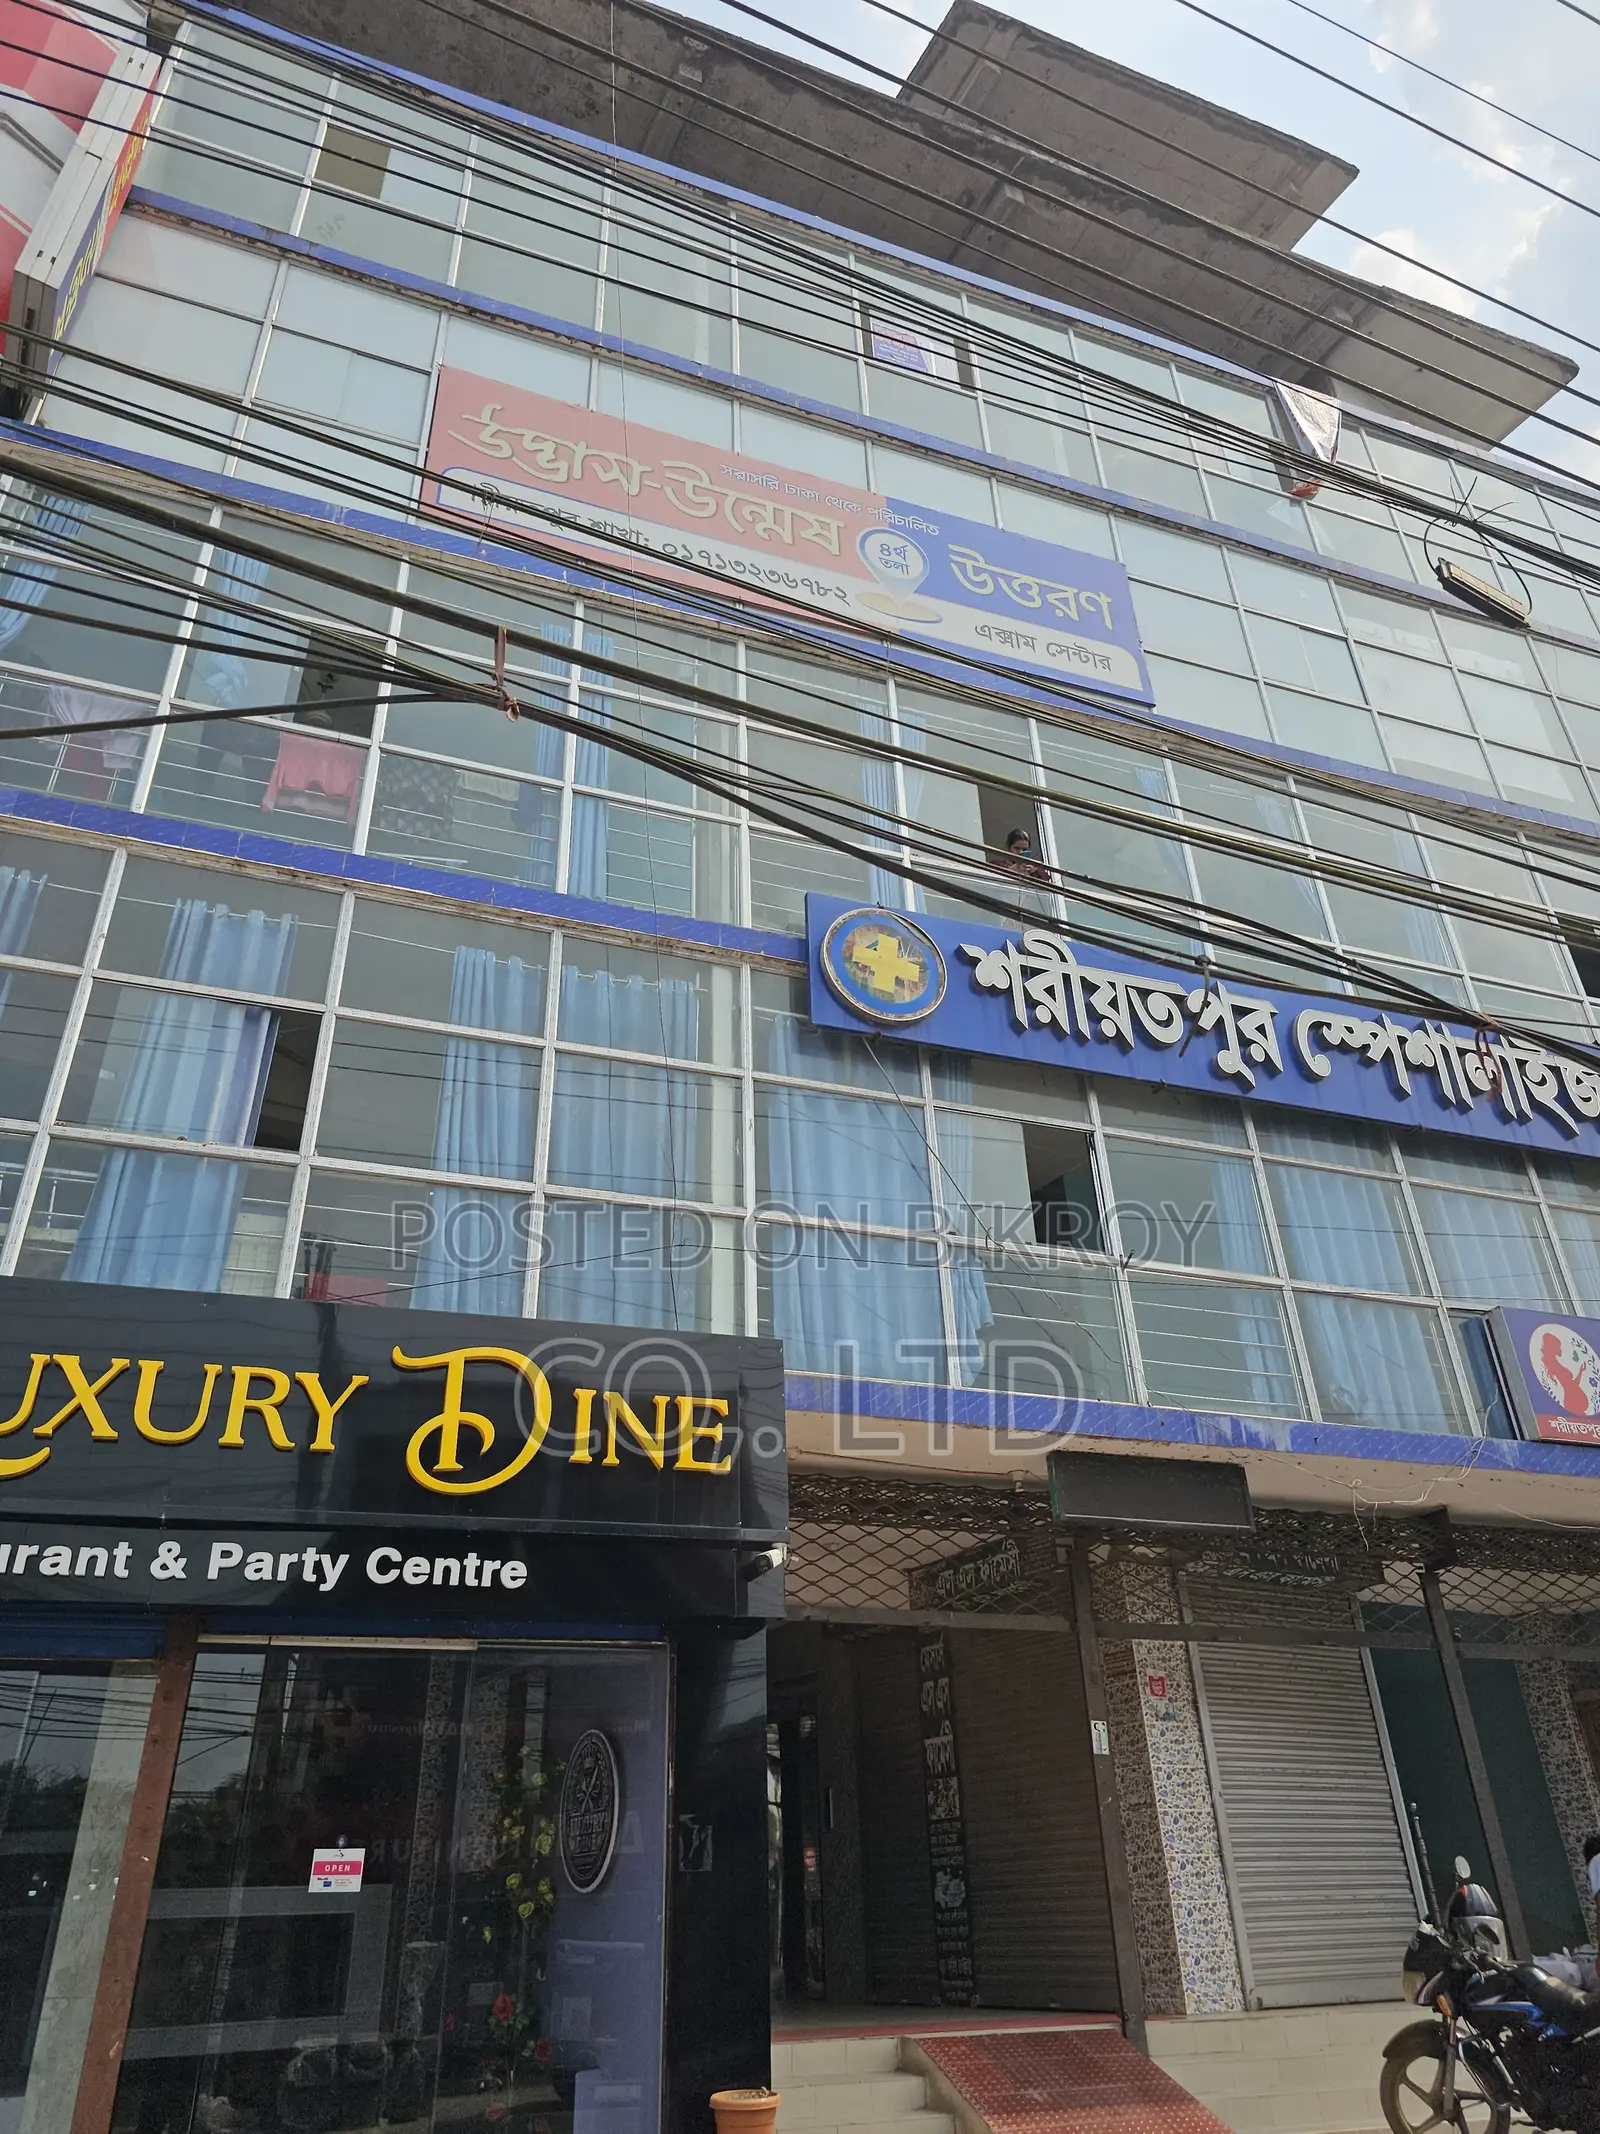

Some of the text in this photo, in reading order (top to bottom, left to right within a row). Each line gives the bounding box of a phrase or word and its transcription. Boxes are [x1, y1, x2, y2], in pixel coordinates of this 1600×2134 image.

[719, 463, 941, 536] সরাসরি ঢাকা থেকে পরিচালিত
[877, 556, 911, 577] তলা
[947, 542, 1114, 632] উত্তরণ
[974, 622, 1113, 673] এক্সাম সেন্টার
[957, 928, 1285, 1092] শরীয়তপুর
[0, 1354, 369, 1480] UXURY
[150, 1540, 188, 1582] &
[206, 1542, 350, 1593] Party
[366, 1546, 530, 1590] Centre
[324, 1864, 351, 1872] OPEN
